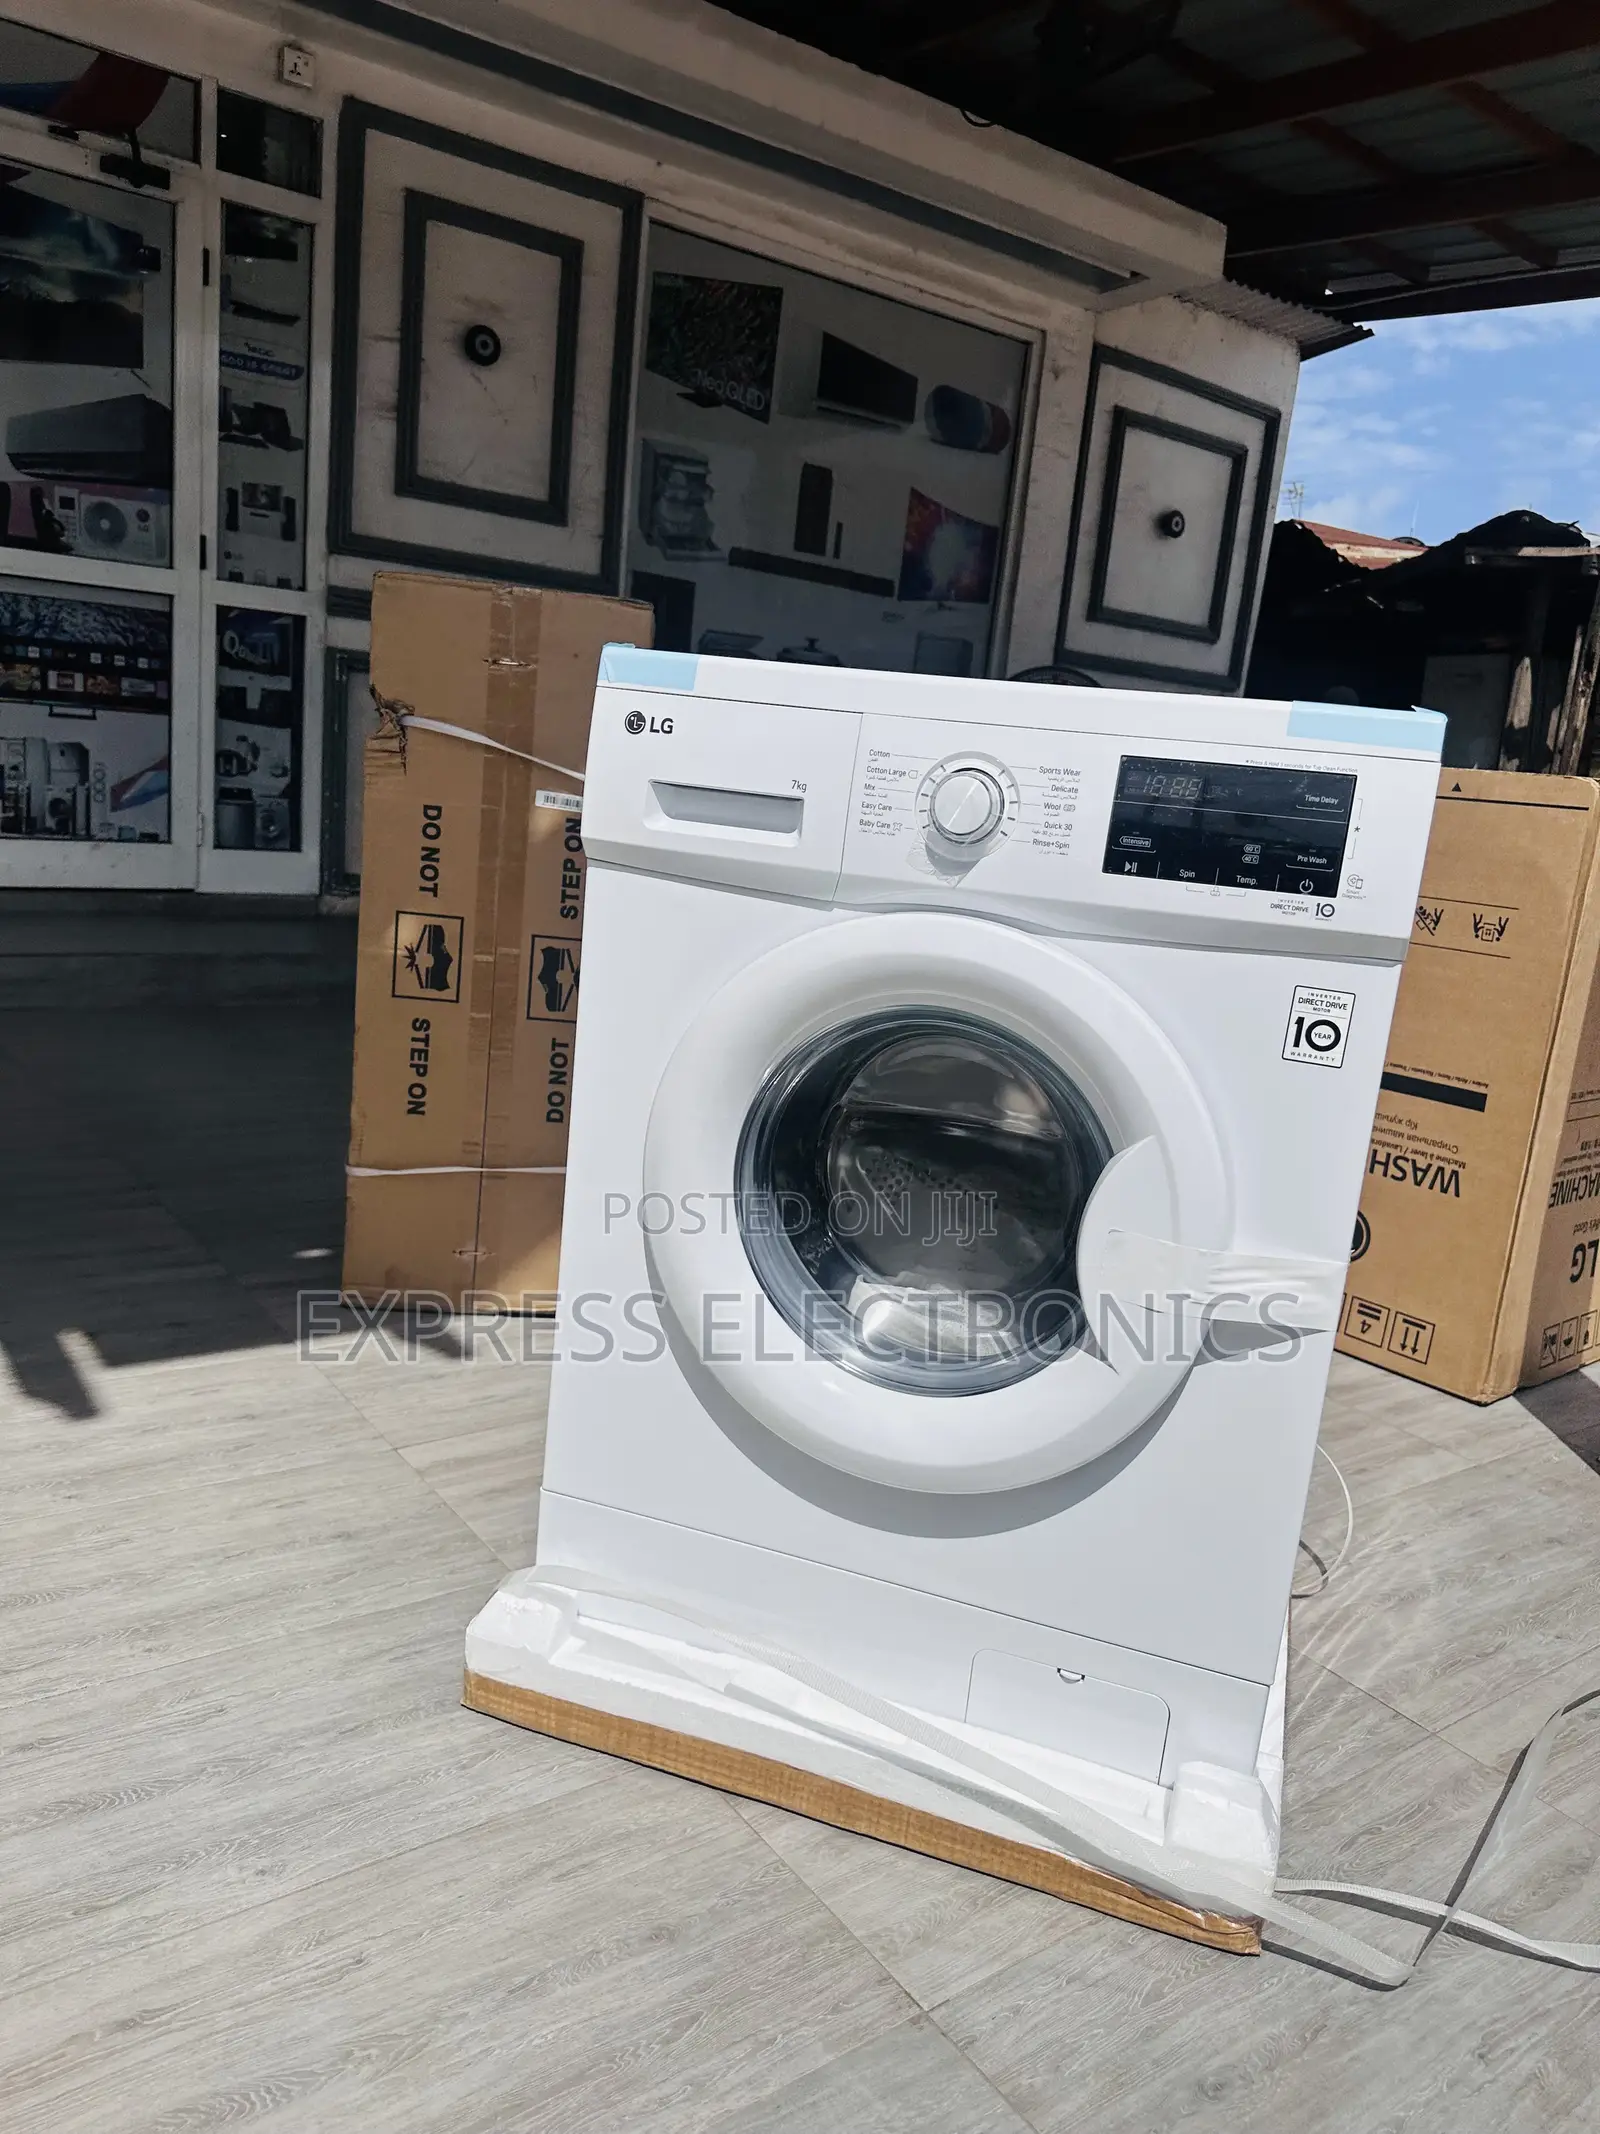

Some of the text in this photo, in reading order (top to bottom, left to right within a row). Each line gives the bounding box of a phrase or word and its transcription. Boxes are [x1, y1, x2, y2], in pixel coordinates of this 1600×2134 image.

[726, 381, 765, 411] QLED
[649, 716, 674, 735] LG
[869, 749, 890, 758] Cotton
[866, 765, 907, 777] Cotton Large
[1039, 766, 1081, 777] Sports Wear
[791, 779, 807, 793] 7kg
[1051, 784, 1079, 794] Delicate
[1305, 794, 1339, 805] Time Delay
[861, 801, 892, 811] Easy Care
[1044, 802, 1061, 811] Wool
[859, 819, 890, 829] Baby Care
[1044, 821, 1073, 831] Quick 30
[1032, 838, 1070, 850] Rinse+Spin
[1122, 836, 1149, 846] Intensive
[419, 804, 442, 898] DO NOT
[1309, 856, 1327, 864] Wash
[561, 817, 583, 921] STEP ON
[1179, 869, 1195, 878] Spin
[1236, 875, 1258, 885] Temp.
[1270, 903, 1310, 913] DIRECT DRIVE
[1315, 902, 1336, 918] 10
[1308, 992, 1342, 1001] INVERTER
[1297, 996, 1349, 1011] DIRECT DRIVE
[1292, 1016, 1342, 1052] 10
[1314, 1032, 1332, 1041] YEAR
[1290, 1051, 1336, 1062] WARRANTY
[406, 1017, 431, 1116] STEP ON
[546, 1037, 570, 1123] DO NOT
[1407, 1133, 1459, 1154] Стиральная
[1410, 1147, 1428, 1160] laver
[1435, 1154, 1467, 1170] Machine
[1369, 1149, 1461, 1198] WASH
[1570, 1239, 1599, 1284] LG
